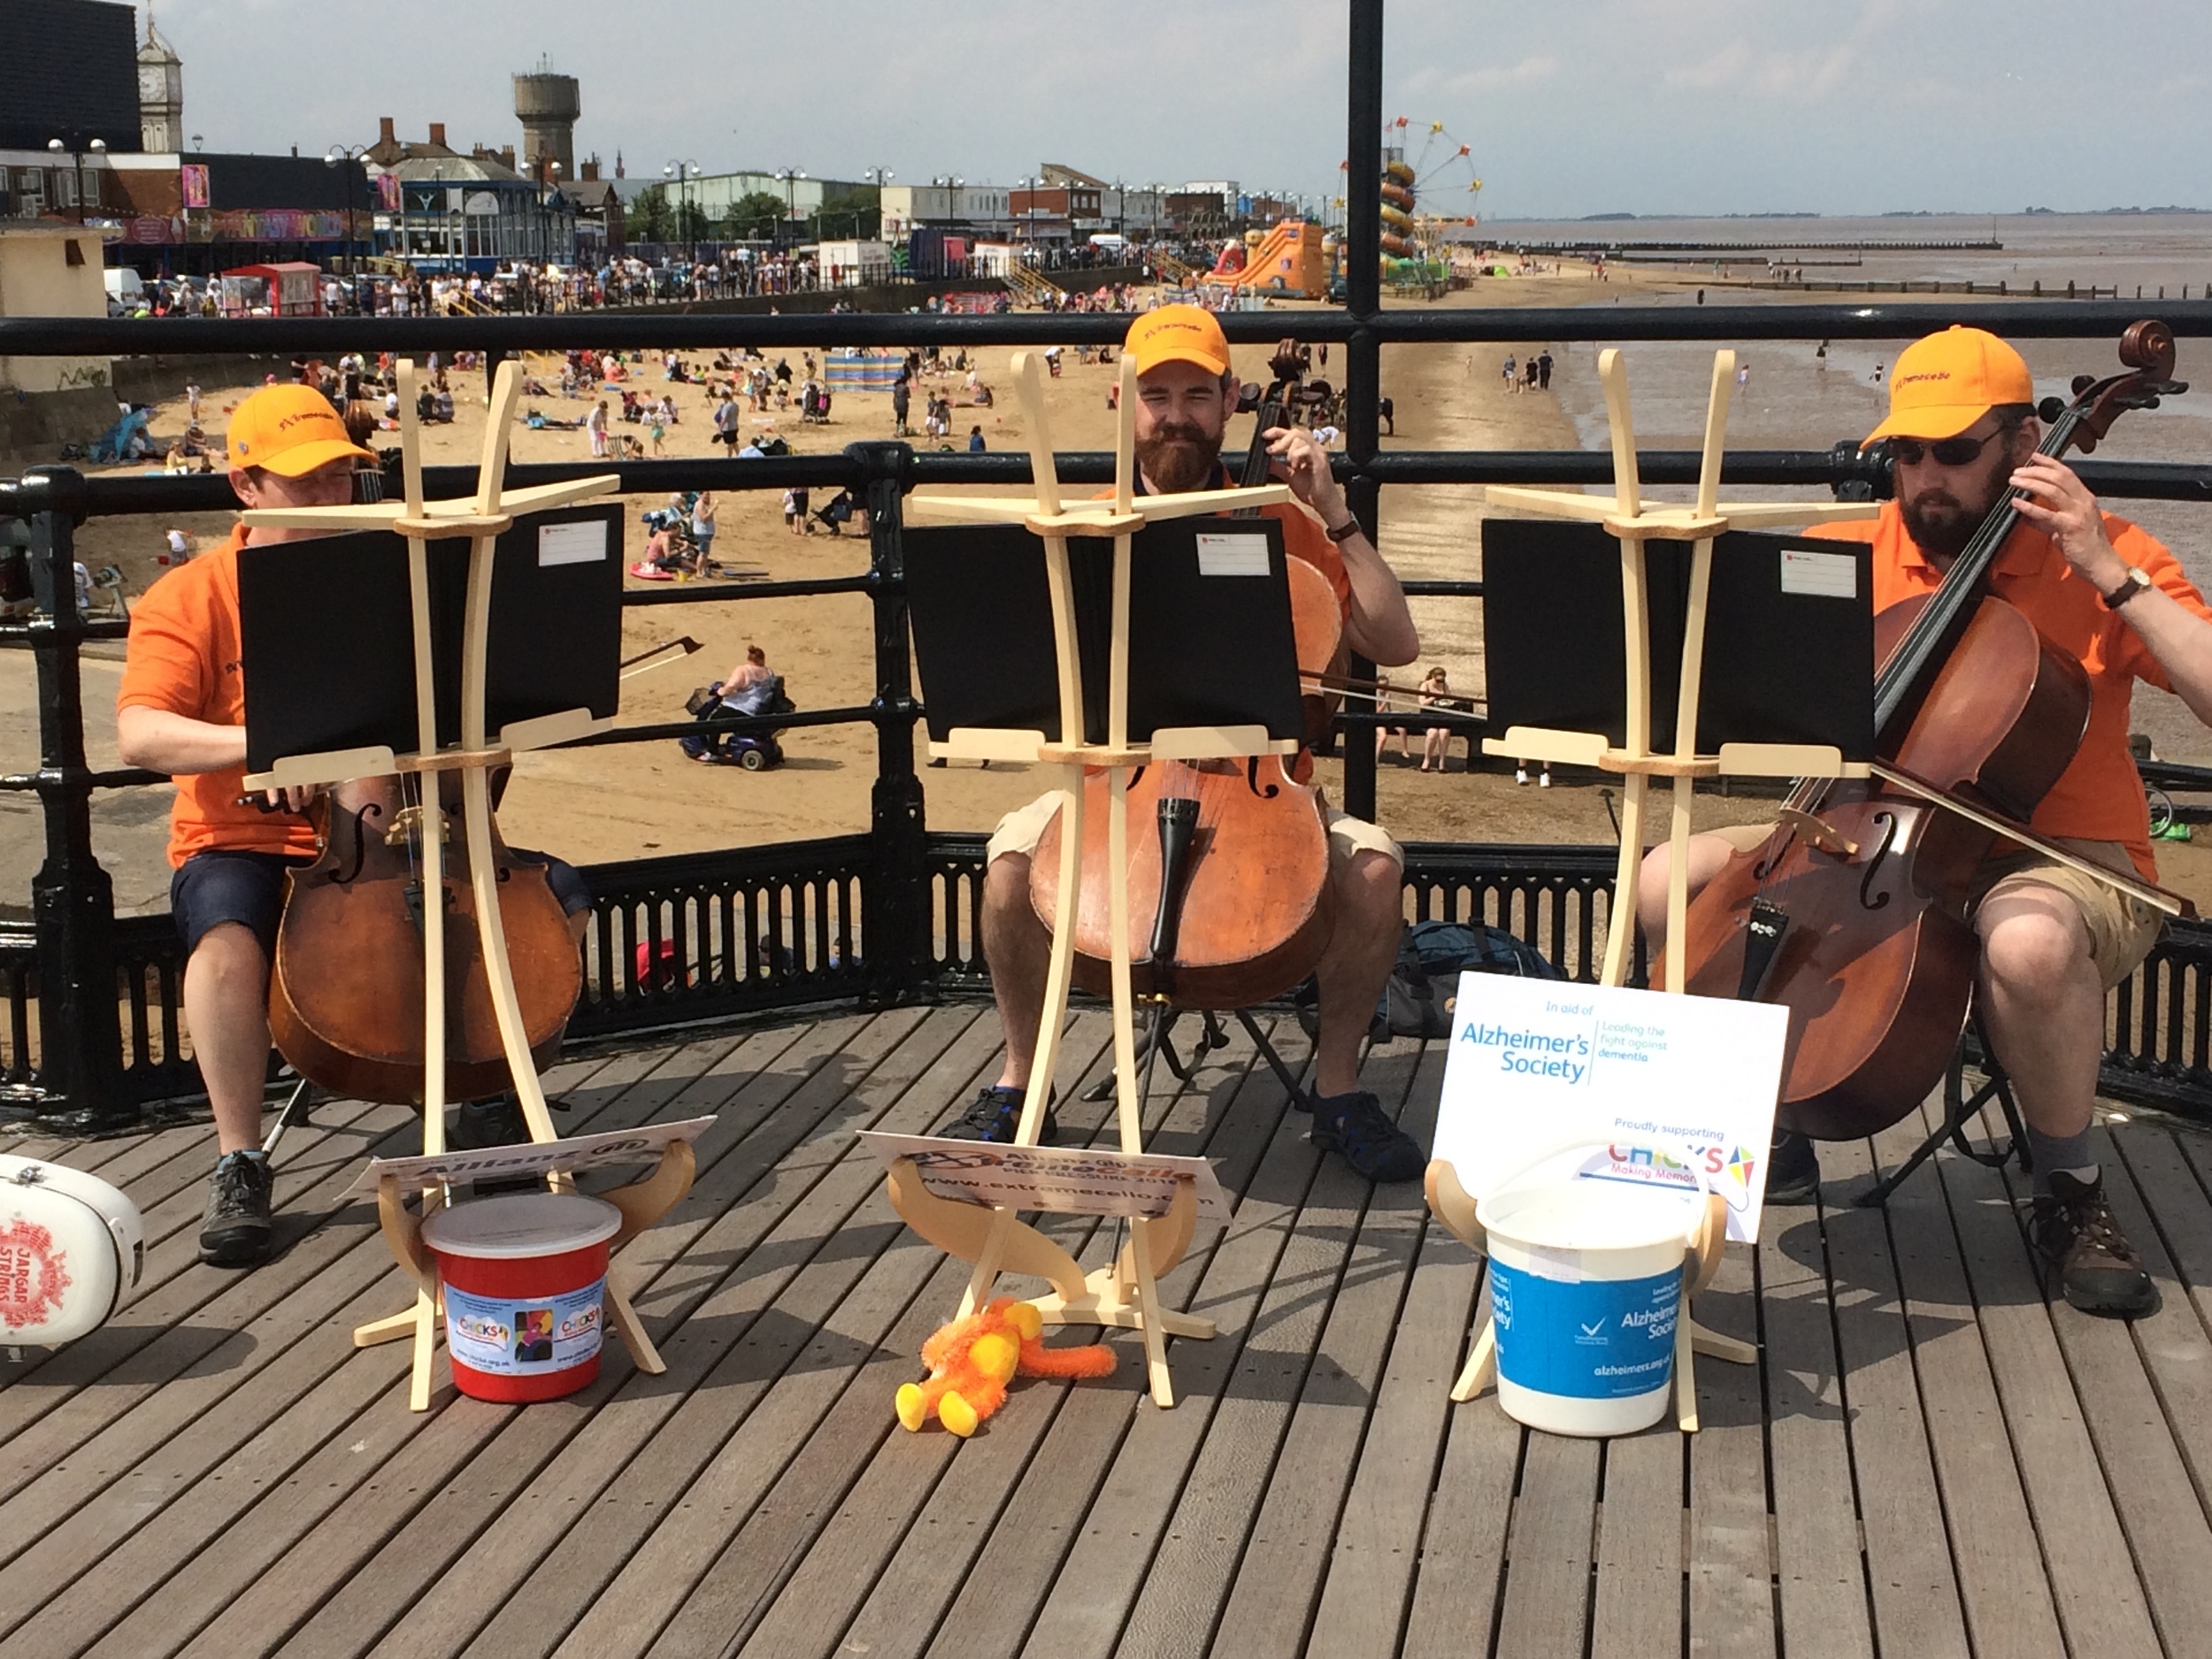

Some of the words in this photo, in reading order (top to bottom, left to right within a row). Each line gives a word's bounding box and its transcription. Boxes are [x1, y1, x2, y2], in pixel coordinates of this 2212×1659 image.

[1546, 1001, 1558, 1012] In
[1561, 1003, 1579, 1015] aid
[1581, 1005, 1594, 1016] of
[1602, 1021, 1645, 1037] Leading
[1647, 1026, 1665, 1037] the
[1459, 1022, 1589, 1055] Alzheimer's
[1601, 1034, 1625, 1048] fight
[1628, 1039, 1668, 1051] against
[1598, 1048, 1648, 1062] dementia
[1501, 1050, 1585, 1085] Society
[1614, 1117, 1659, 1133] Proudly
[1662, 1125, 1724, 1142] supporting
[417, 1149, 581, 1176] Allianz
[1006, 1152, 1089, 1164] Allianz
[1610, 1163, 1652, 1179] Making
[14, 1247, 31, 1304] JARGAR
[459, 1317, 498, 1337] CHICKS
